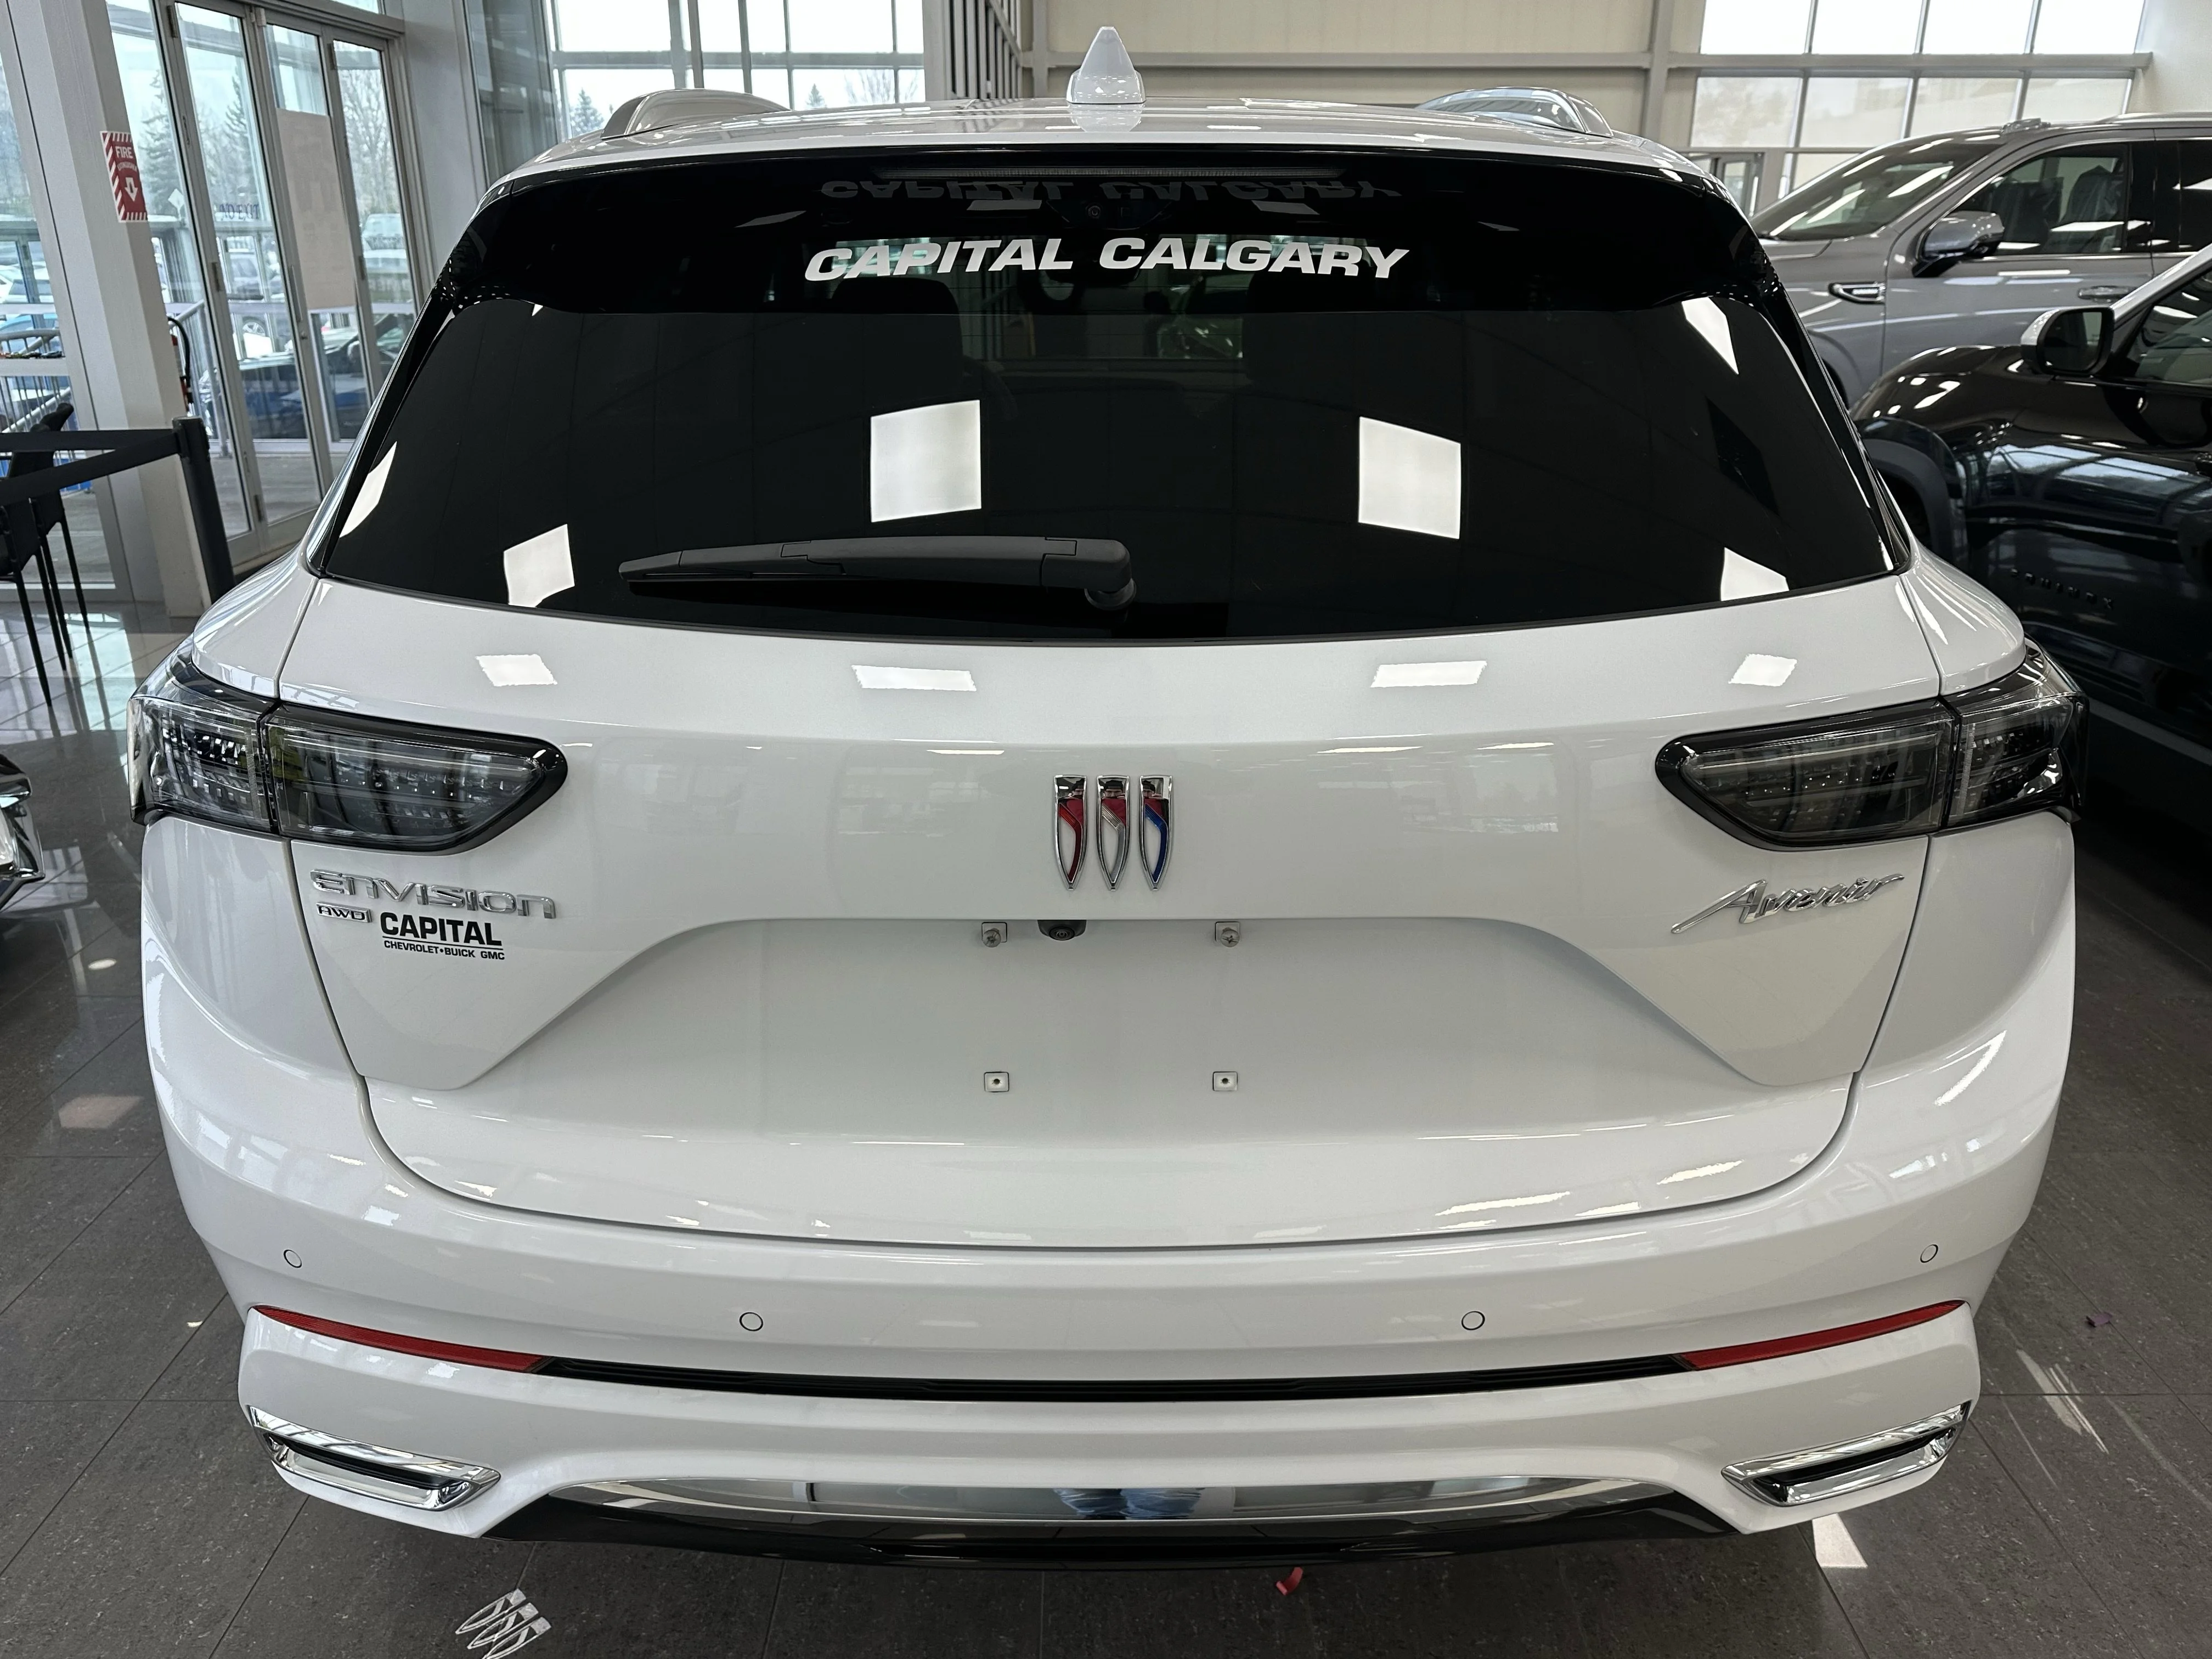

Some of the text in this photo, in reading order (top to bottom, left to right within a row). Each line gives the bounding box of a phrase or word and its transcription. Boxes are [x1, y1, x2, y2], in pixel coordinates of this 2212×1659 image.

[115, 146, 133, 159] FIRE
[236, 203, 259, 221] EXIT
[804, 238, 1410, 281] CAPITAL CALGARY
[310, 868, 556, 919] ENVISION
[1671, 873, 1905, 934] Avenir
[318, 905, 366, 921] AWD
[380, 912, 502, 946] CAPITAL
[481, 951, 505, 961] GMC
